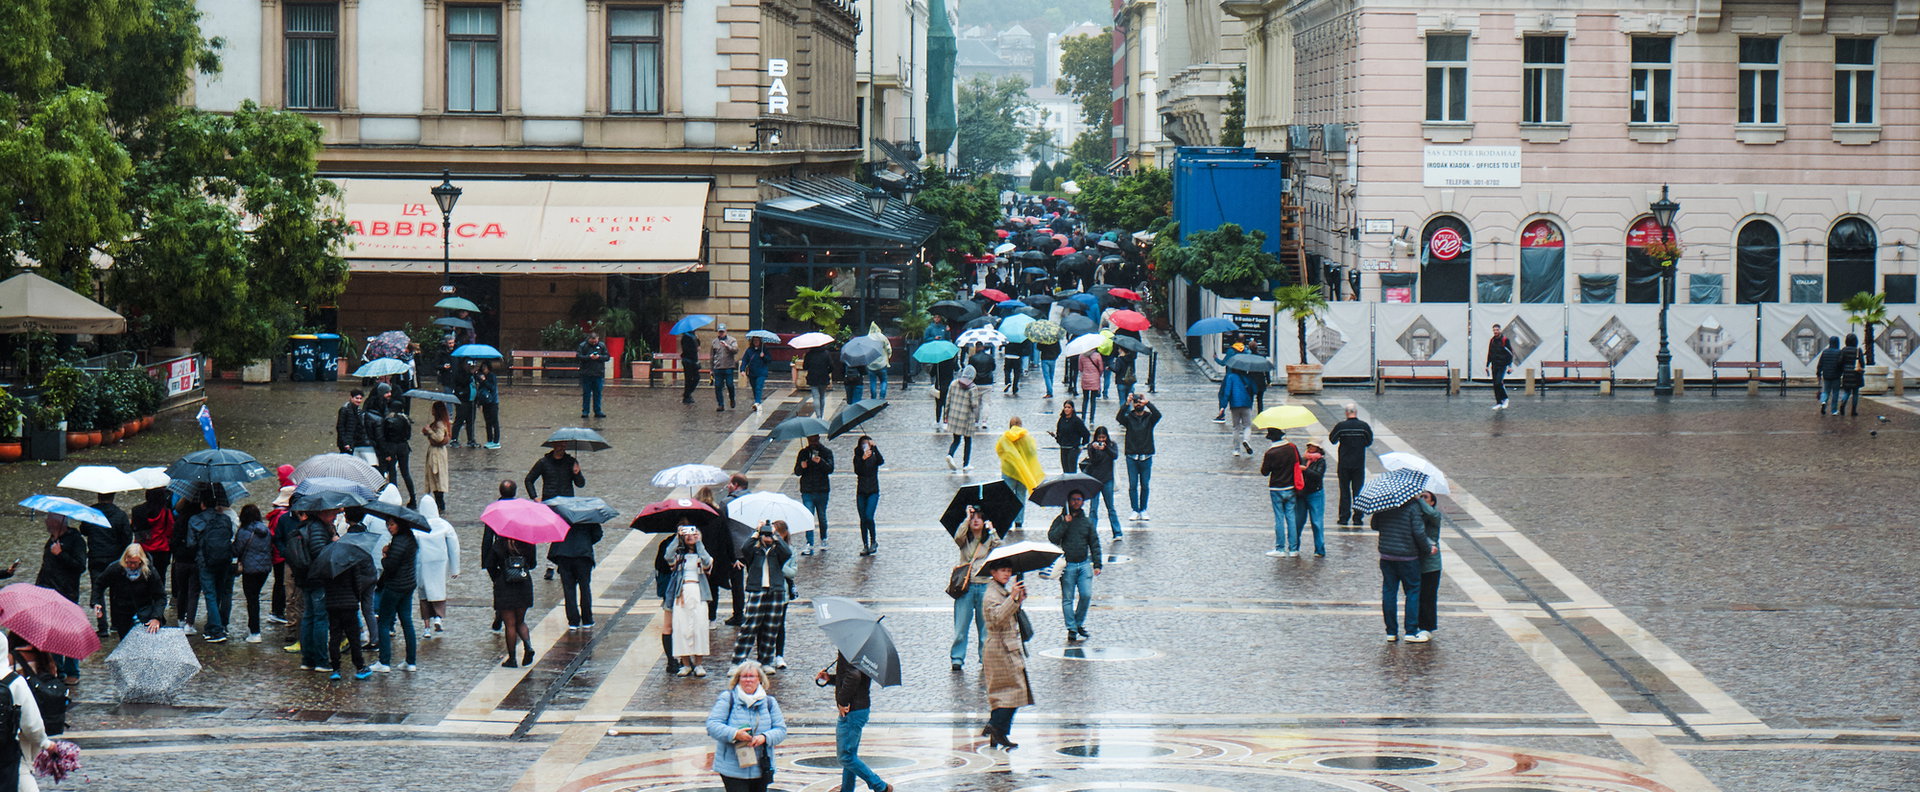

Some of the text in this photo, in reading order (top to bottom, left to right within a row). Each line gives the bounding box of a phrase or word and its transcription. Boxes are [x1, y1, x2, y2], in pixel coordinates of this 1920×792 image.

[768, 58, 789, 114] BAR
[1443, 149, 1474, 157] CENTER
[402, 203, 431, 216] LA
